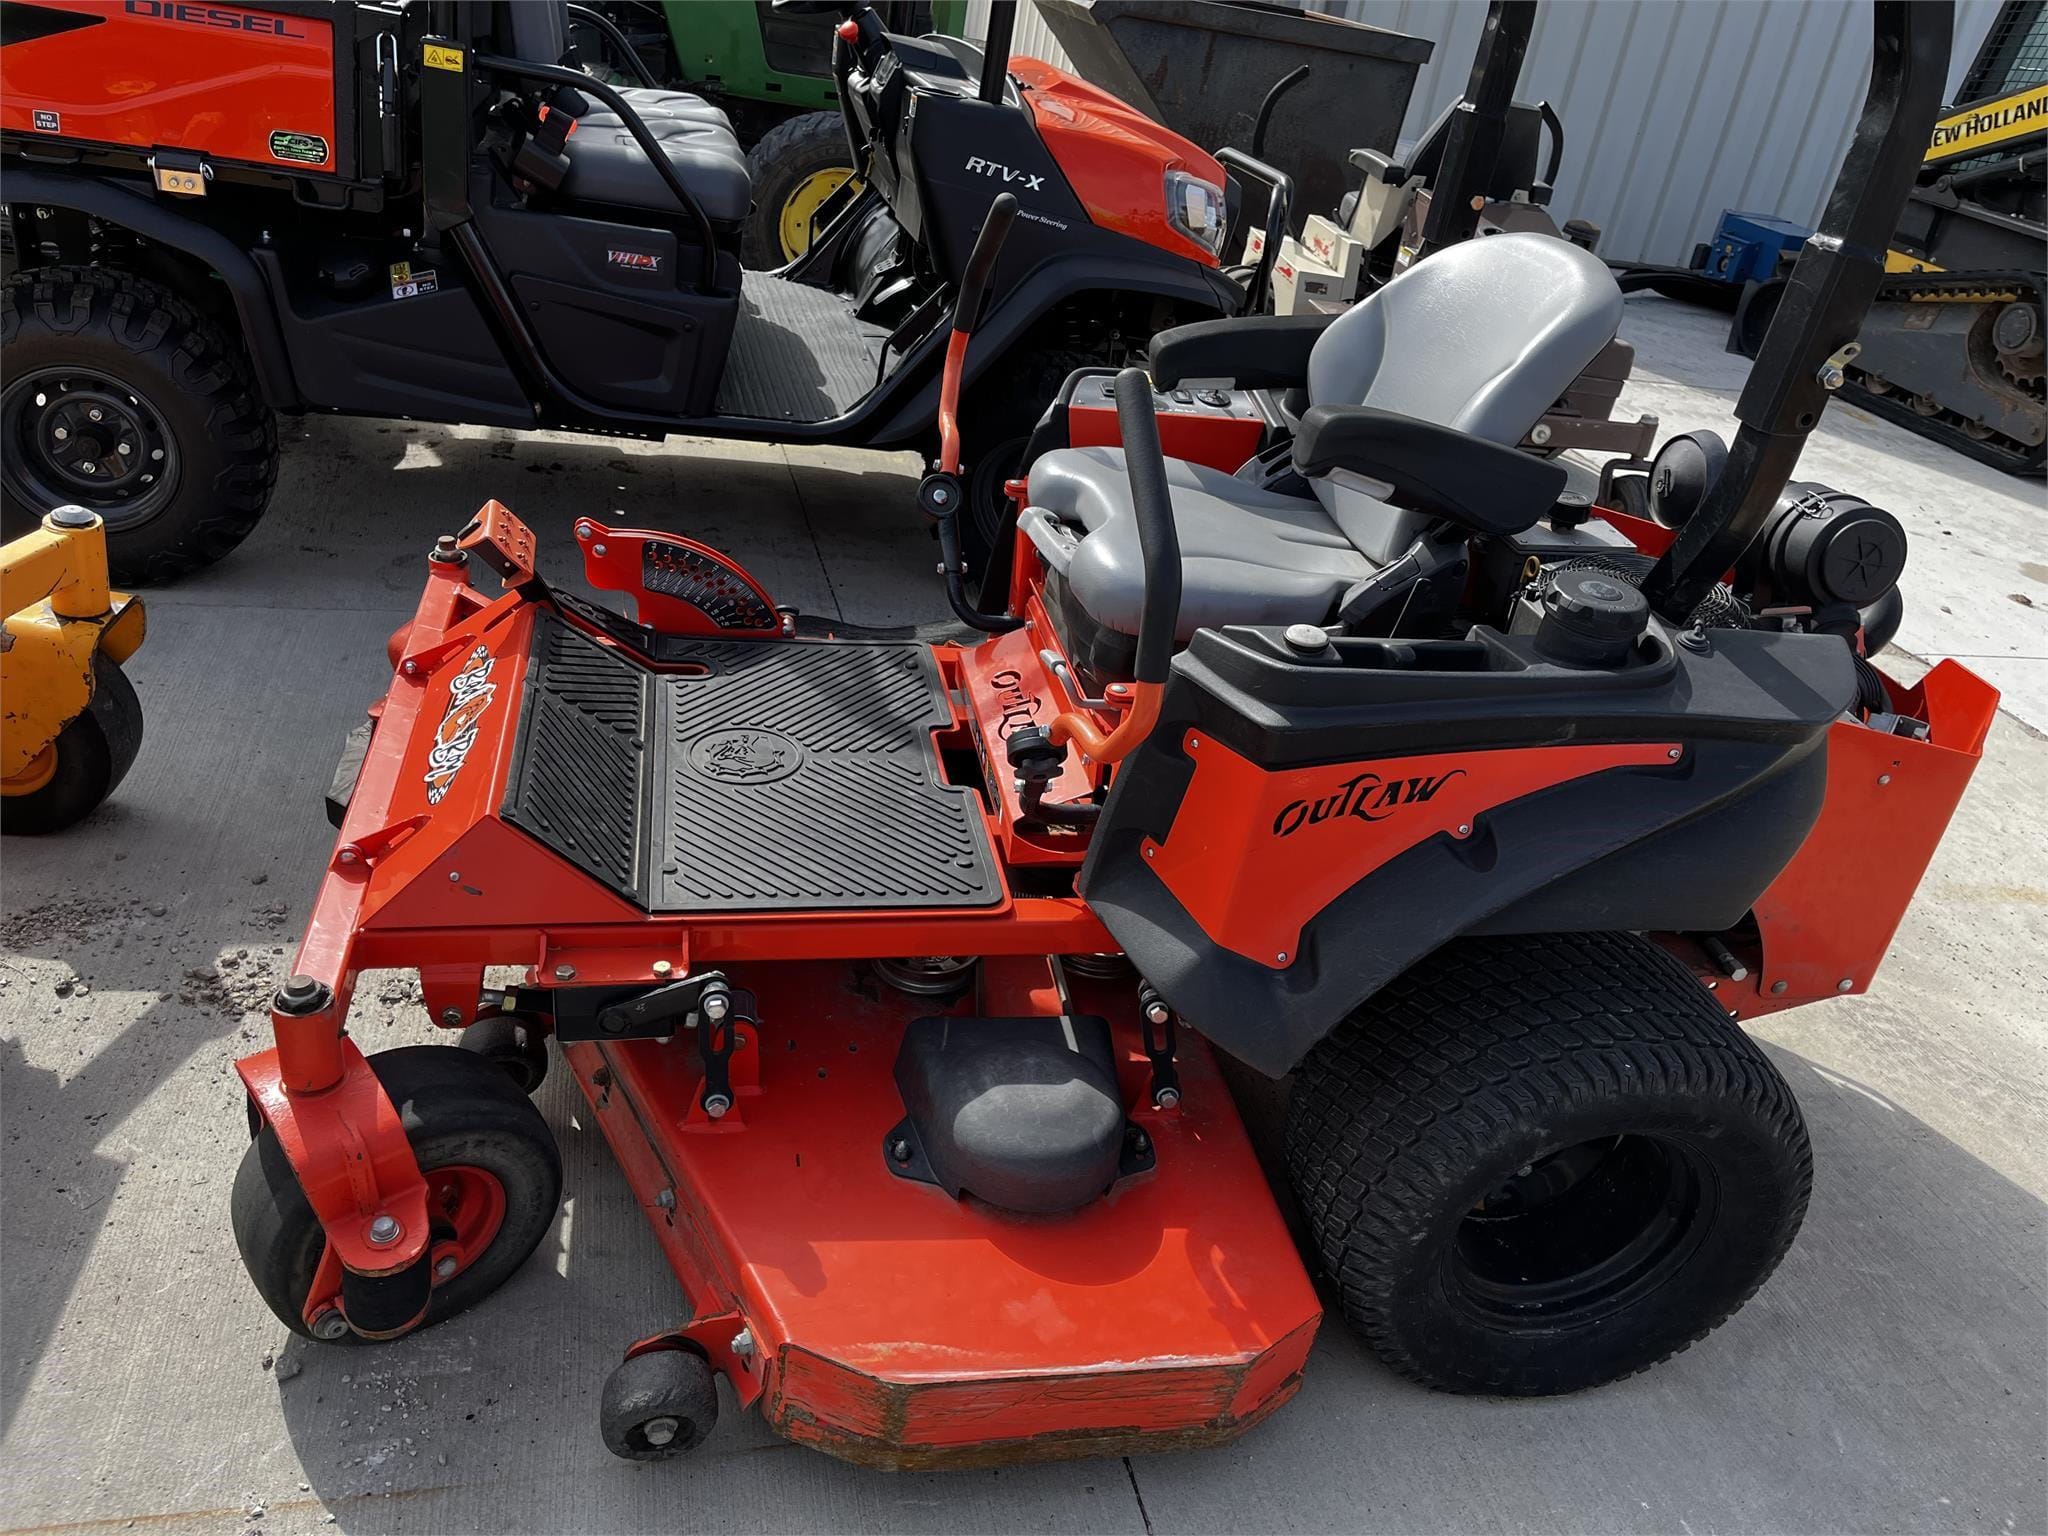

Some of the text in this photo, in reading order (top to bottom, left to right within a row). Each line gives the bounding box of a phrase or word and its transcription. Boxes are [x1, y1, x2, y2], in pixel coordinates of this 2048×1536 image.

[125, 0, 305, 38] DIESEL
[36, 120, 57, 129] STEP
[40, 113, 53, 121] NO
[1931, 125, 1960, 147] EW
[965, 156, 1045, 191] RTV-X
[1016, 209, 1068, 231] Power Steering
